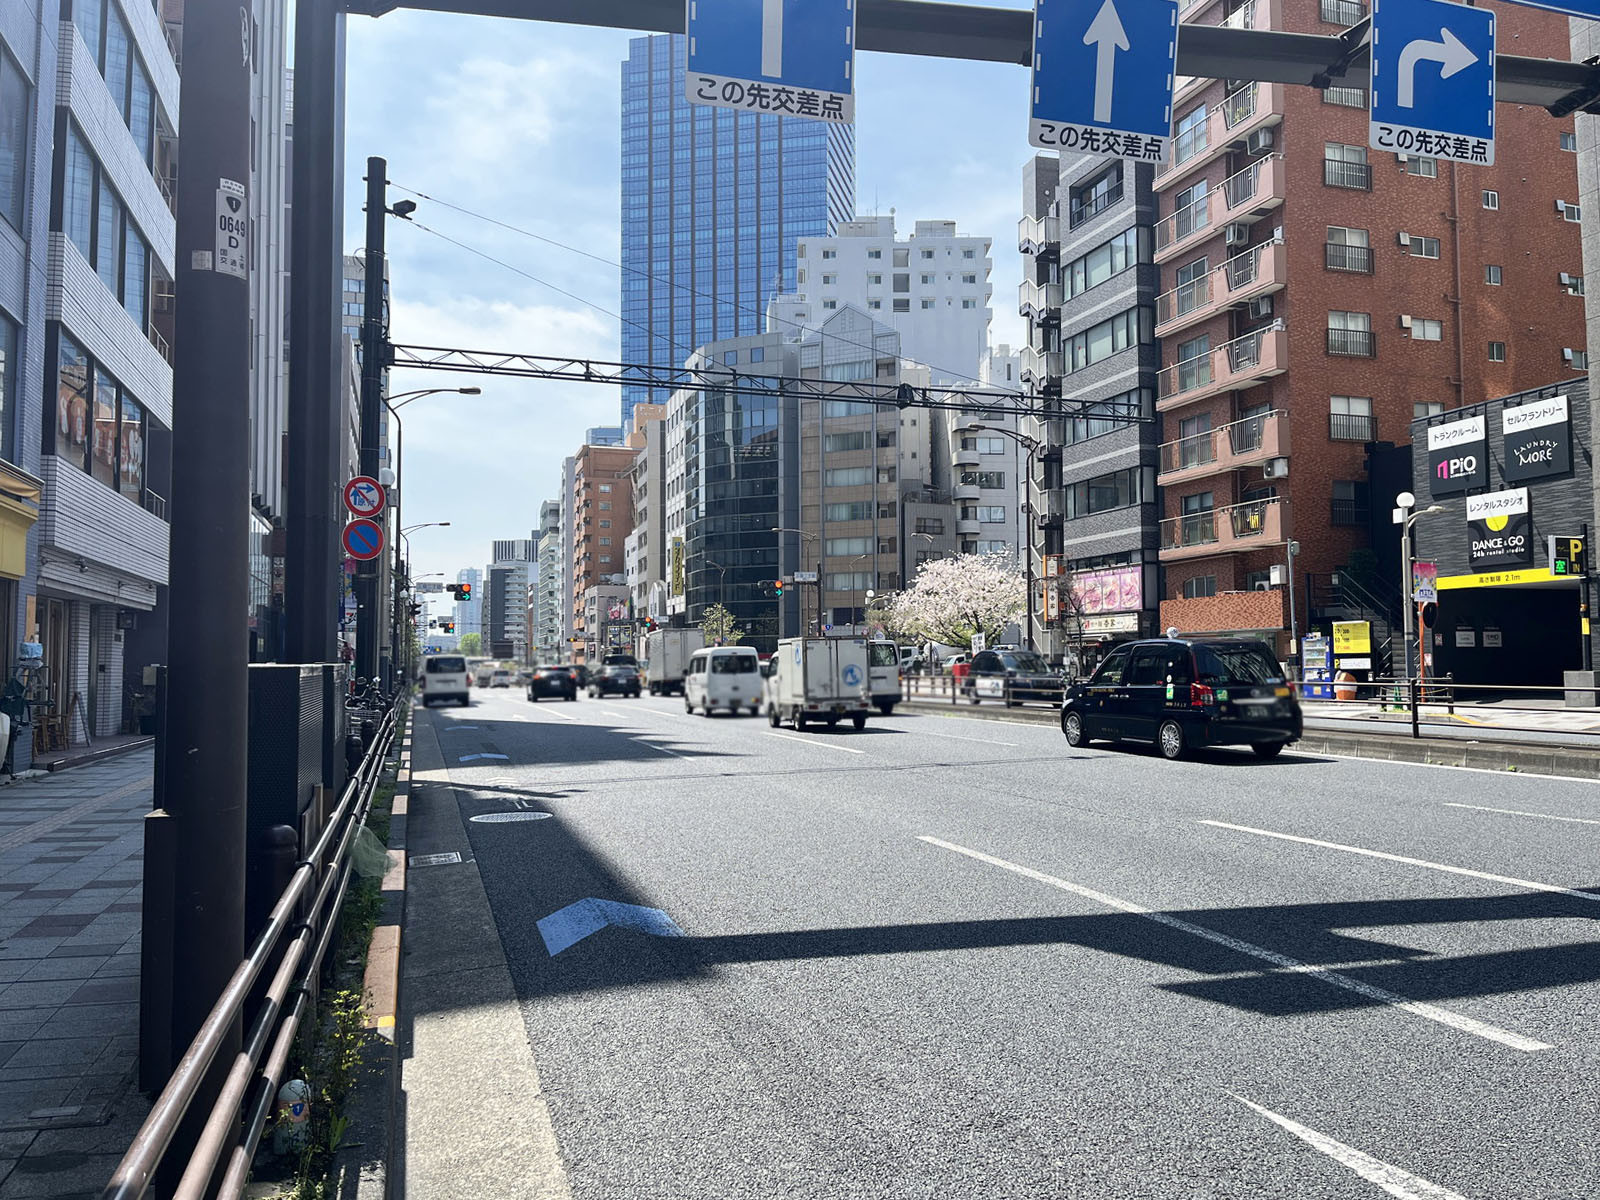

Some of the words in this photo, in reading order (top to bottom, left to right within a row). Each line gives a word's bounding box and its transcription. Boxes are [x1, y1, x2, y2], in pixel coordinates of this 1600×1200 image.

[697, 78, 844, 120] この先交差点
[1039, 124, 1163, 161] この先交差点
[1378, 127, 1488, 162] この先交差点
[220, 215, 245, 237] 0649
[229, 236, 239, 249] D
[1434, 426, 1478, 442] トランクルーム
[1514, 440, 1558, 456] LAUNDRY
[1449, 455, 1477, 475] PiO
[1519, 448, 1553, 466] MORE
[1470, 497, 1523, 512] レンタルスタジオ
[1472, 538, 1503, 551] DANCE
[1508, 535, 1525, 547] GO
[1569, 539, 1582, 562] P
[1472, 550, 1485, 558] 24h
[1555, 560, 1566, 573] 空
[1505, 575, 1521, 583] 2.1m
